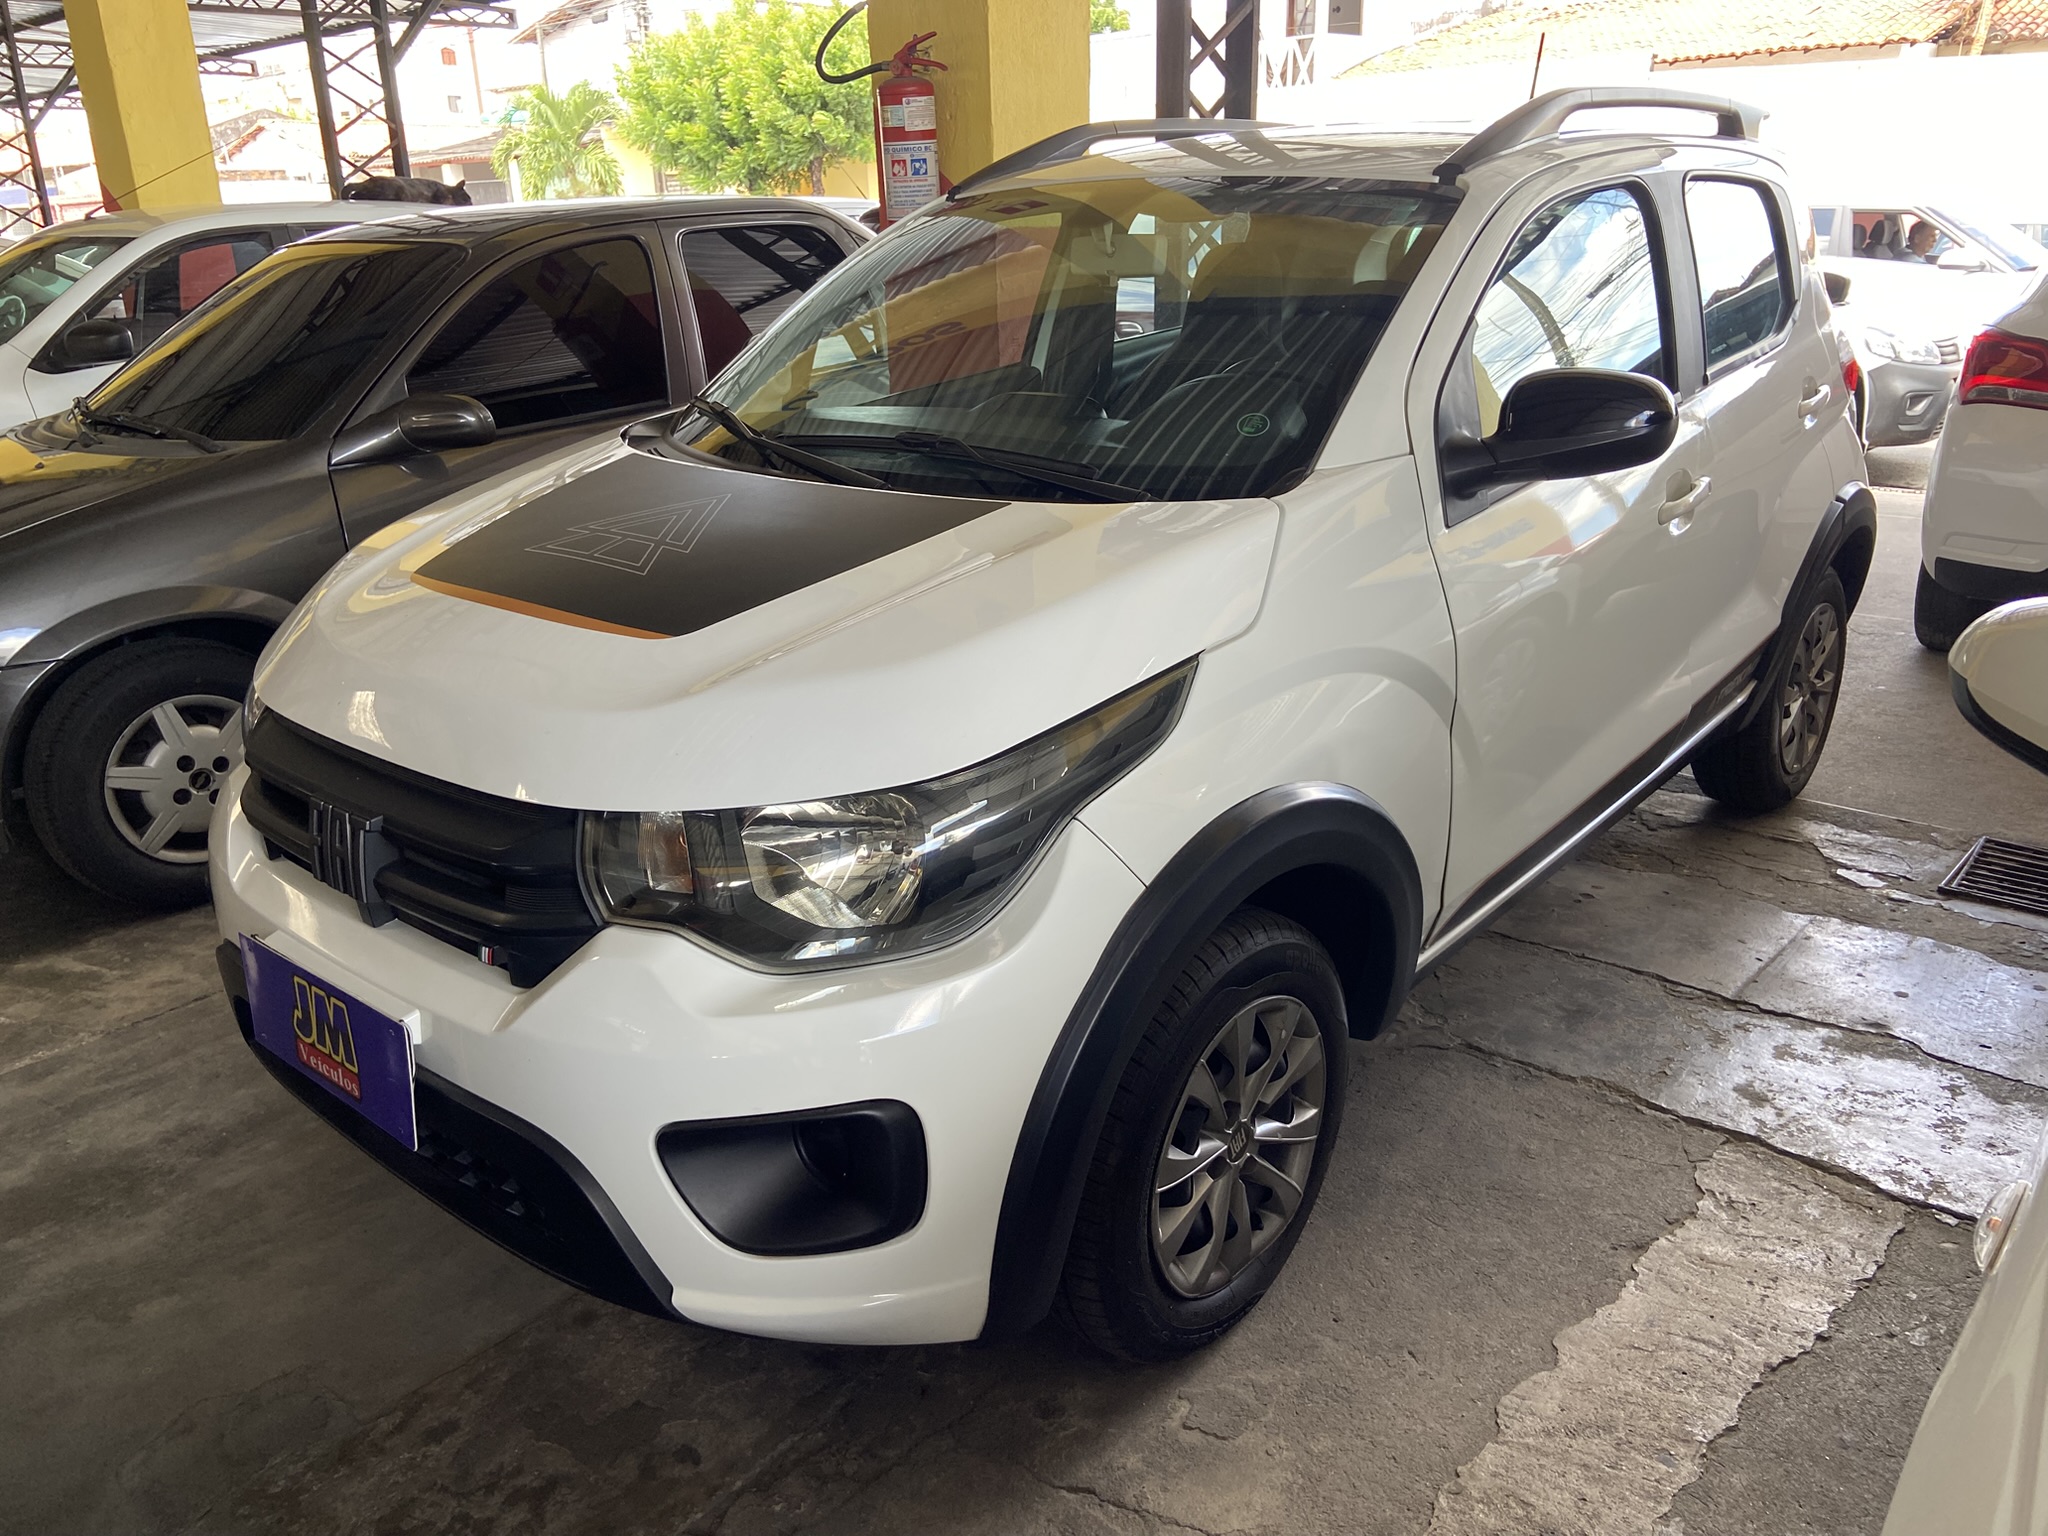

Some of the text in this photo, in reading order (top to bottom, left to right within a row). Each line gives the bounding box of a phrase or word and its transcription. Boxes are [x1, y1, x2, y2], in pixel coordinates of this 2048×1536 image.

[311, 797, 372, 904] FIAT
[292, 975, 358, 1073] JM
[1229, 1127, 1247, 1159] FIAT
